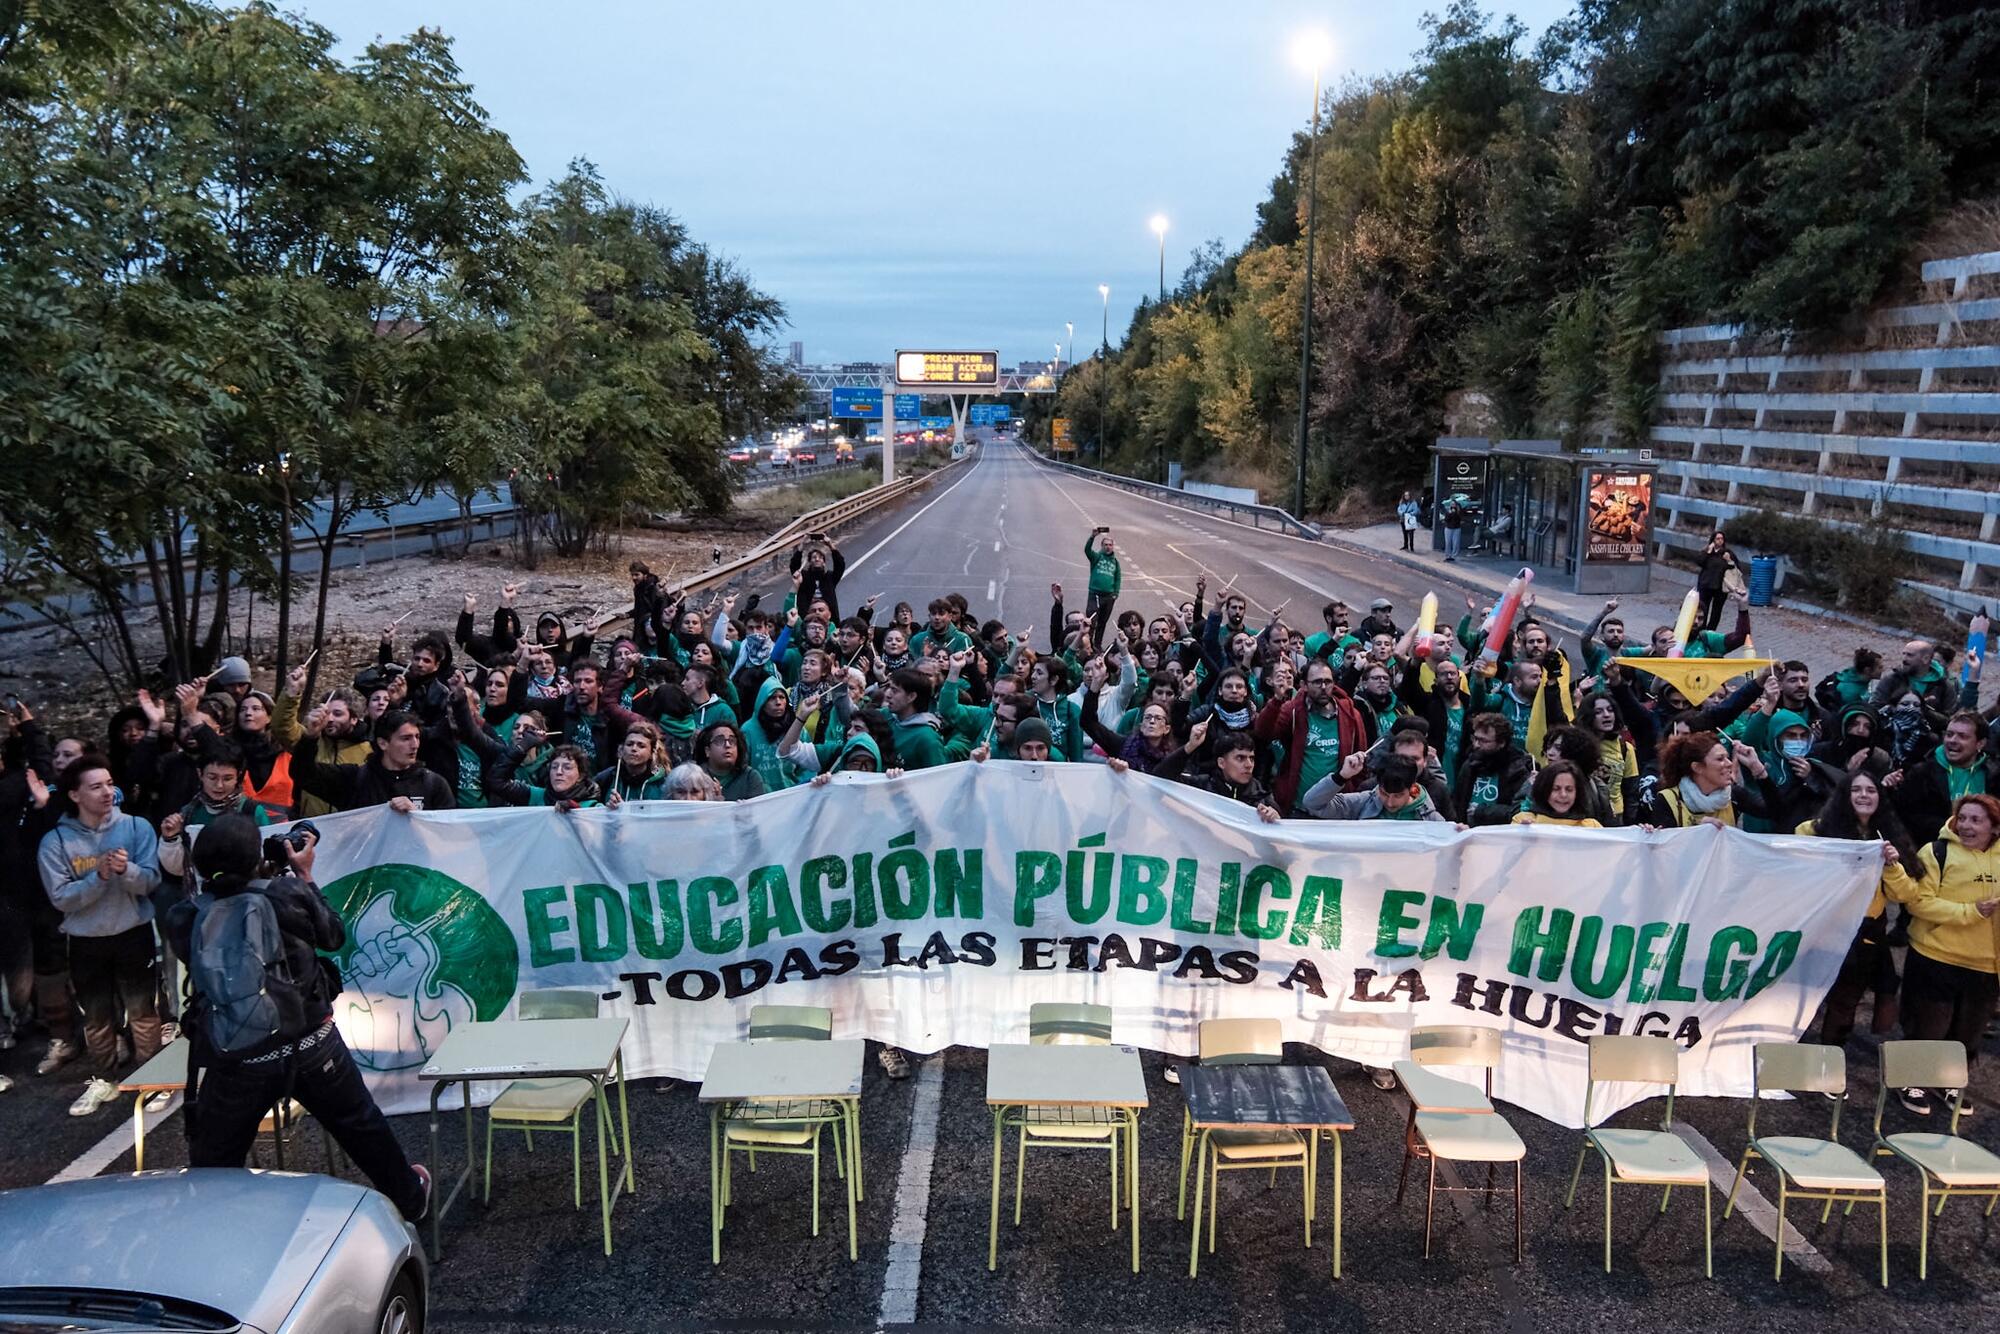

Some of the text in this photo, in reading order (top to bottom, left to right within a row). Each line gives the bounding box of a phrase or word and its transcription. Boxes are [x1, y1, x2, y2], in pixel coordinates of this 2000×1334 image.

[924, 354, 983, 363] PRECAUCION
[924, 363, 994, 372] OBRAS ACCESO
[924, 372, 977, 381] CONDE CAS
[1590, 543, 1644, 554] NASHVILLE CHICKEN
[523, 831, 1802, 1004] EDUCACIÓN PÚBLICA EN HUELGA
[602, 939, 860, 1005] -TODAS
[881, 931, 997, 969] LAS
[1019, 933, 1260, 984] ETAPAS
[1278, 958, 1328, 998] A
[1349, 968, 1430, 1003] LA
